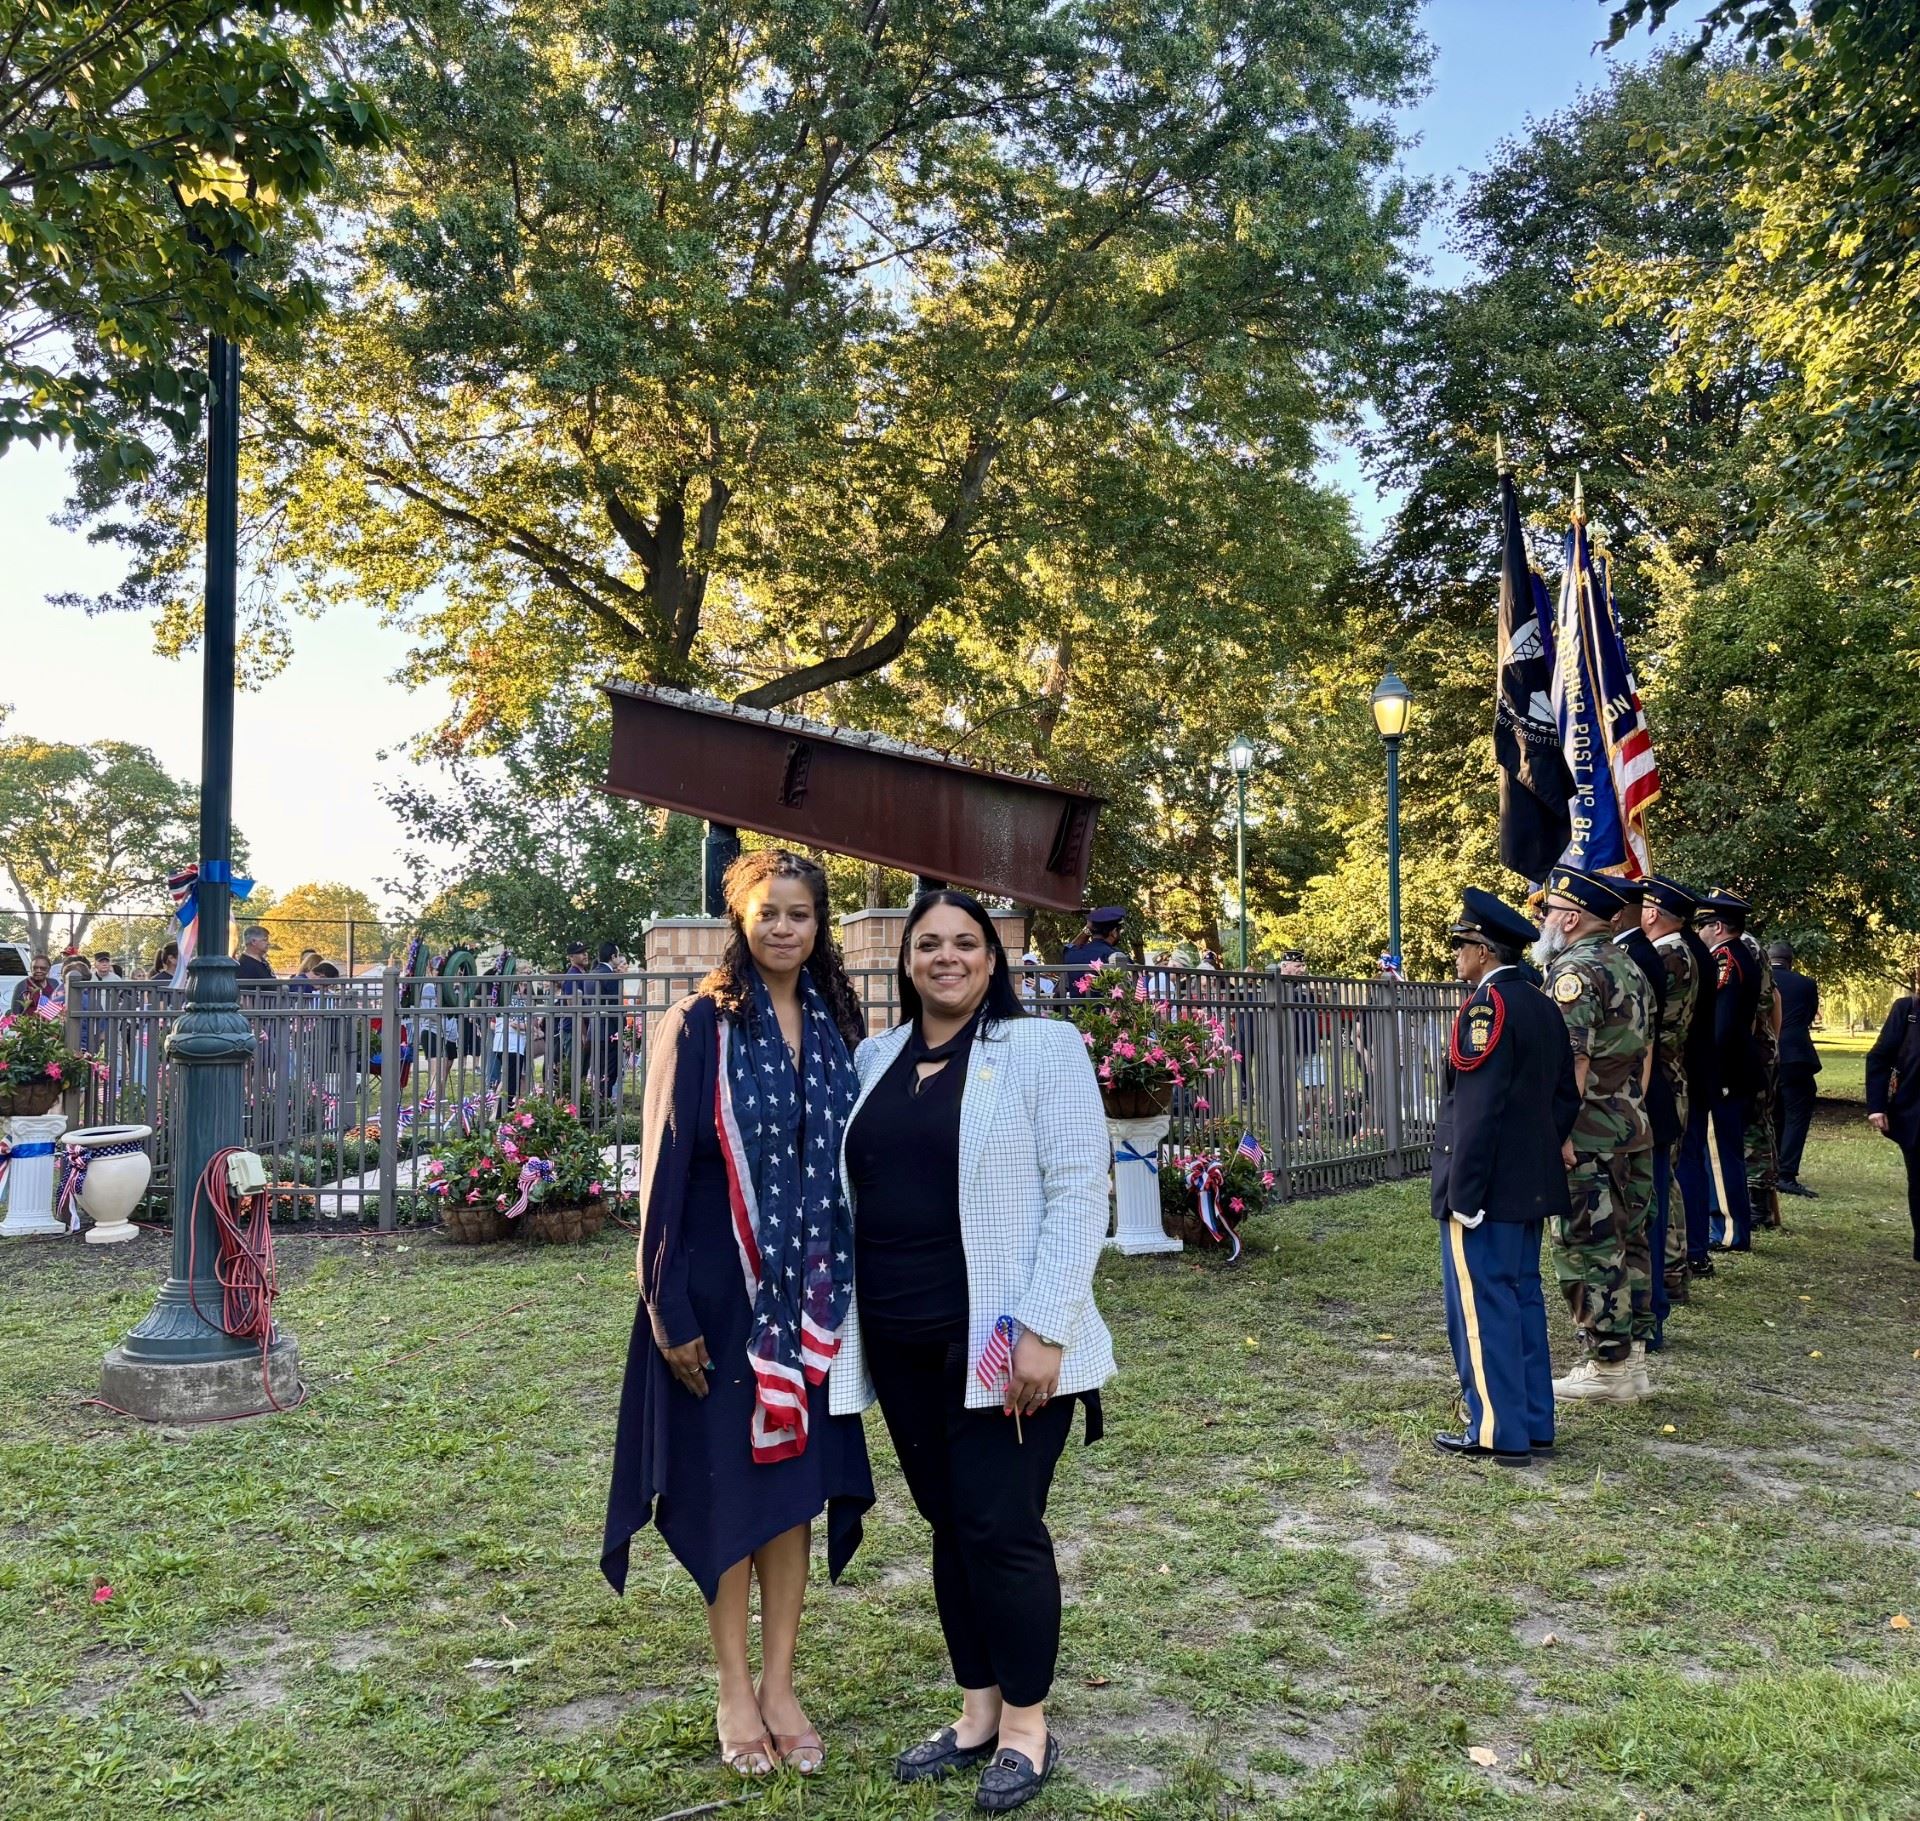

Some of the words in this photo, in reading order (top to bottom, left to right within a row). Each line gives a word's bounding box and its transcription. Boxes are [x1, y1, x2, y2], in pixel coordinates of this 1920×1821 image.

[1603, 693, 1631, 722] ON
[1571, 723, 1594, 773] POST
[1570, 817, 1592, 857] 854
[1470, 1019, 1490, 1029] VFW
